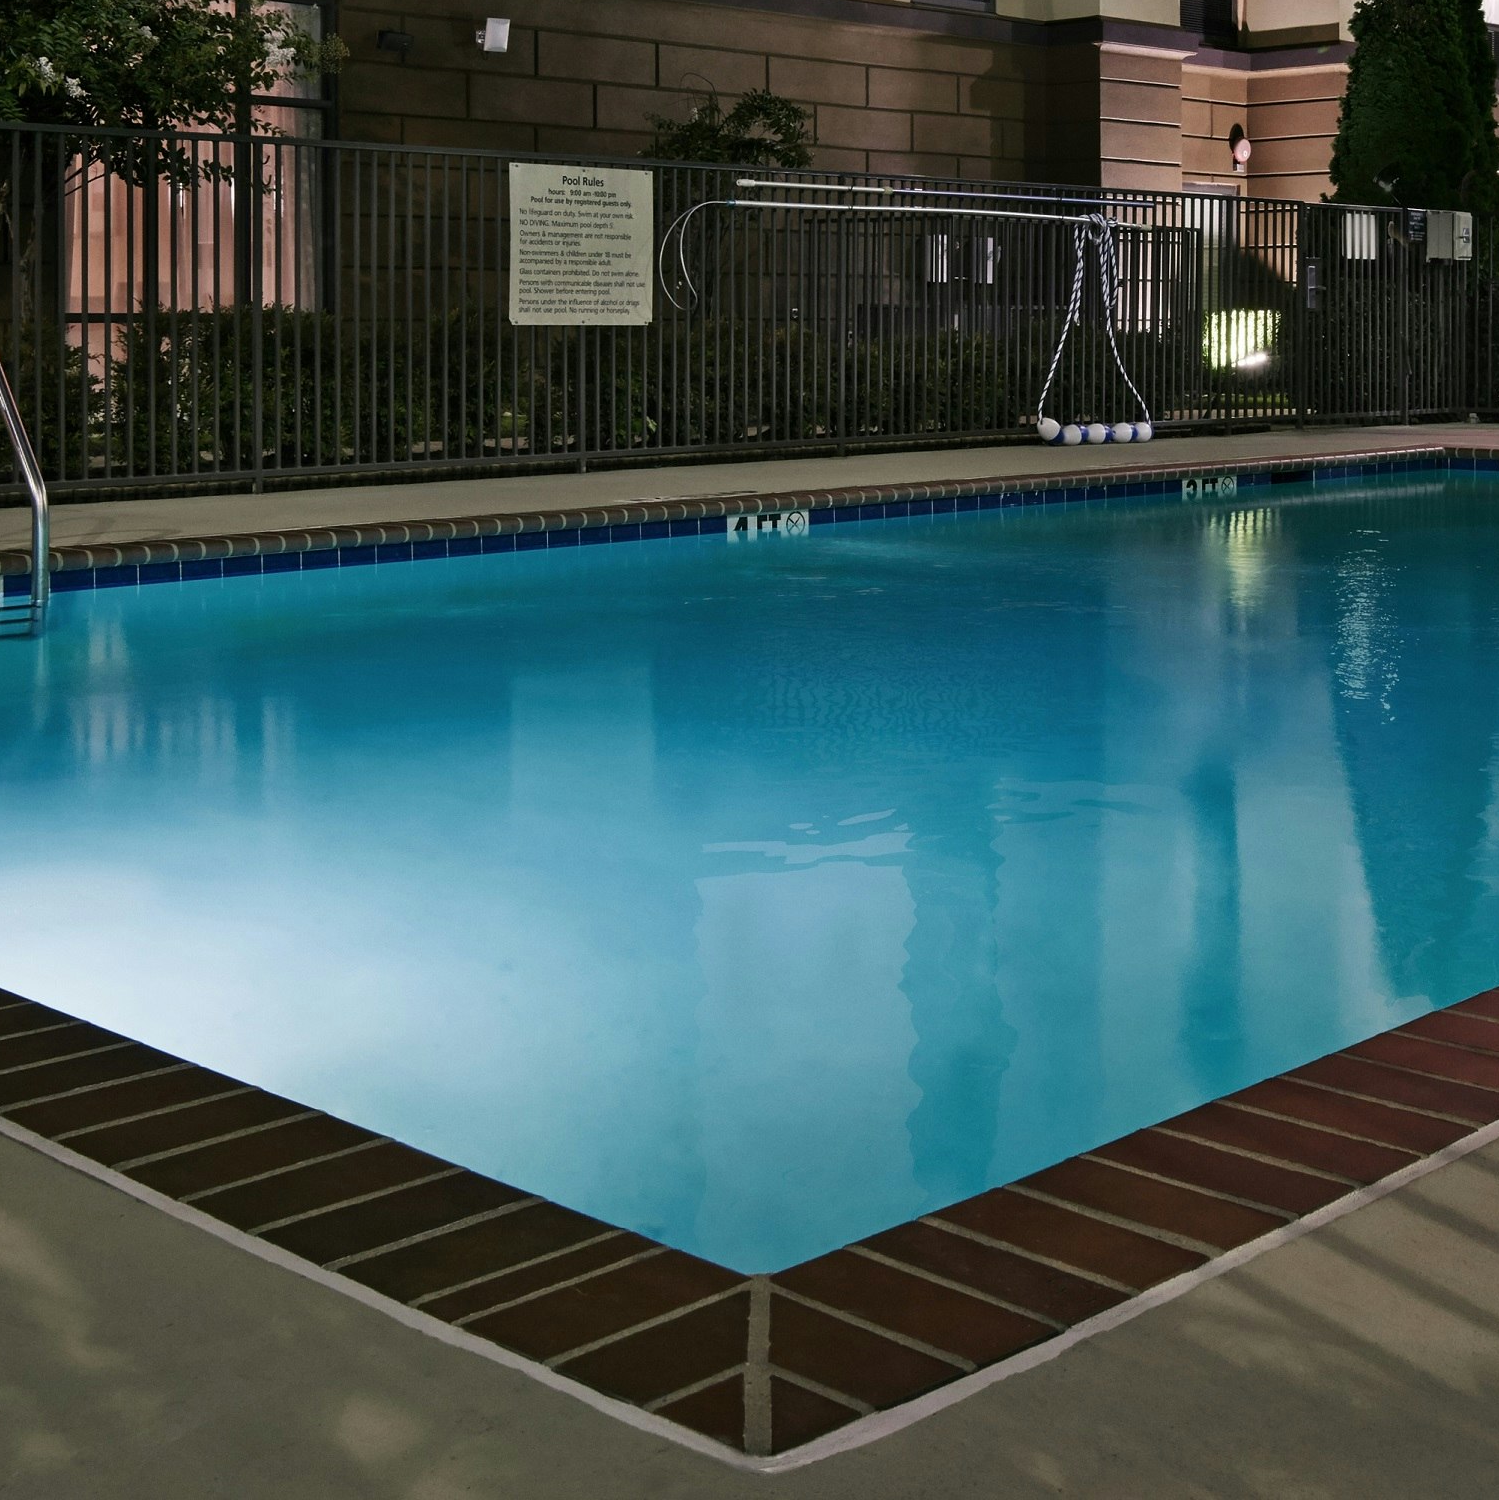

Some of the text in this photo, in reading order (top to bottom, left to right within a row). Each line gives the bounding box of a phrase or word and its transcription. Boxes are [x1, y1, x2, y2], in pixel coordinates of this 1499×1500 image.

[562, 175, 604, 187] Pool Rules
[566, 198, 572, 206] by
[574, 199, 601, 207] registered
[529, 208, 552, 217] lifeguard
[552, 220, 578, 228] Maximum
[548, 232, 583, 240] management
[625, 251, 632, 259] be
[519, 258, 554, 266] accompanied
[555, 258, 562, 266] by
[569, 259, 598, 267] responsible
[534, 287, 555, 295] Shower
[575, 289, 597, 297] entering
[569, 298, 593, 306] influence
[626, 300, 640, 308] drugs
[578, 308, 599, 316] running
